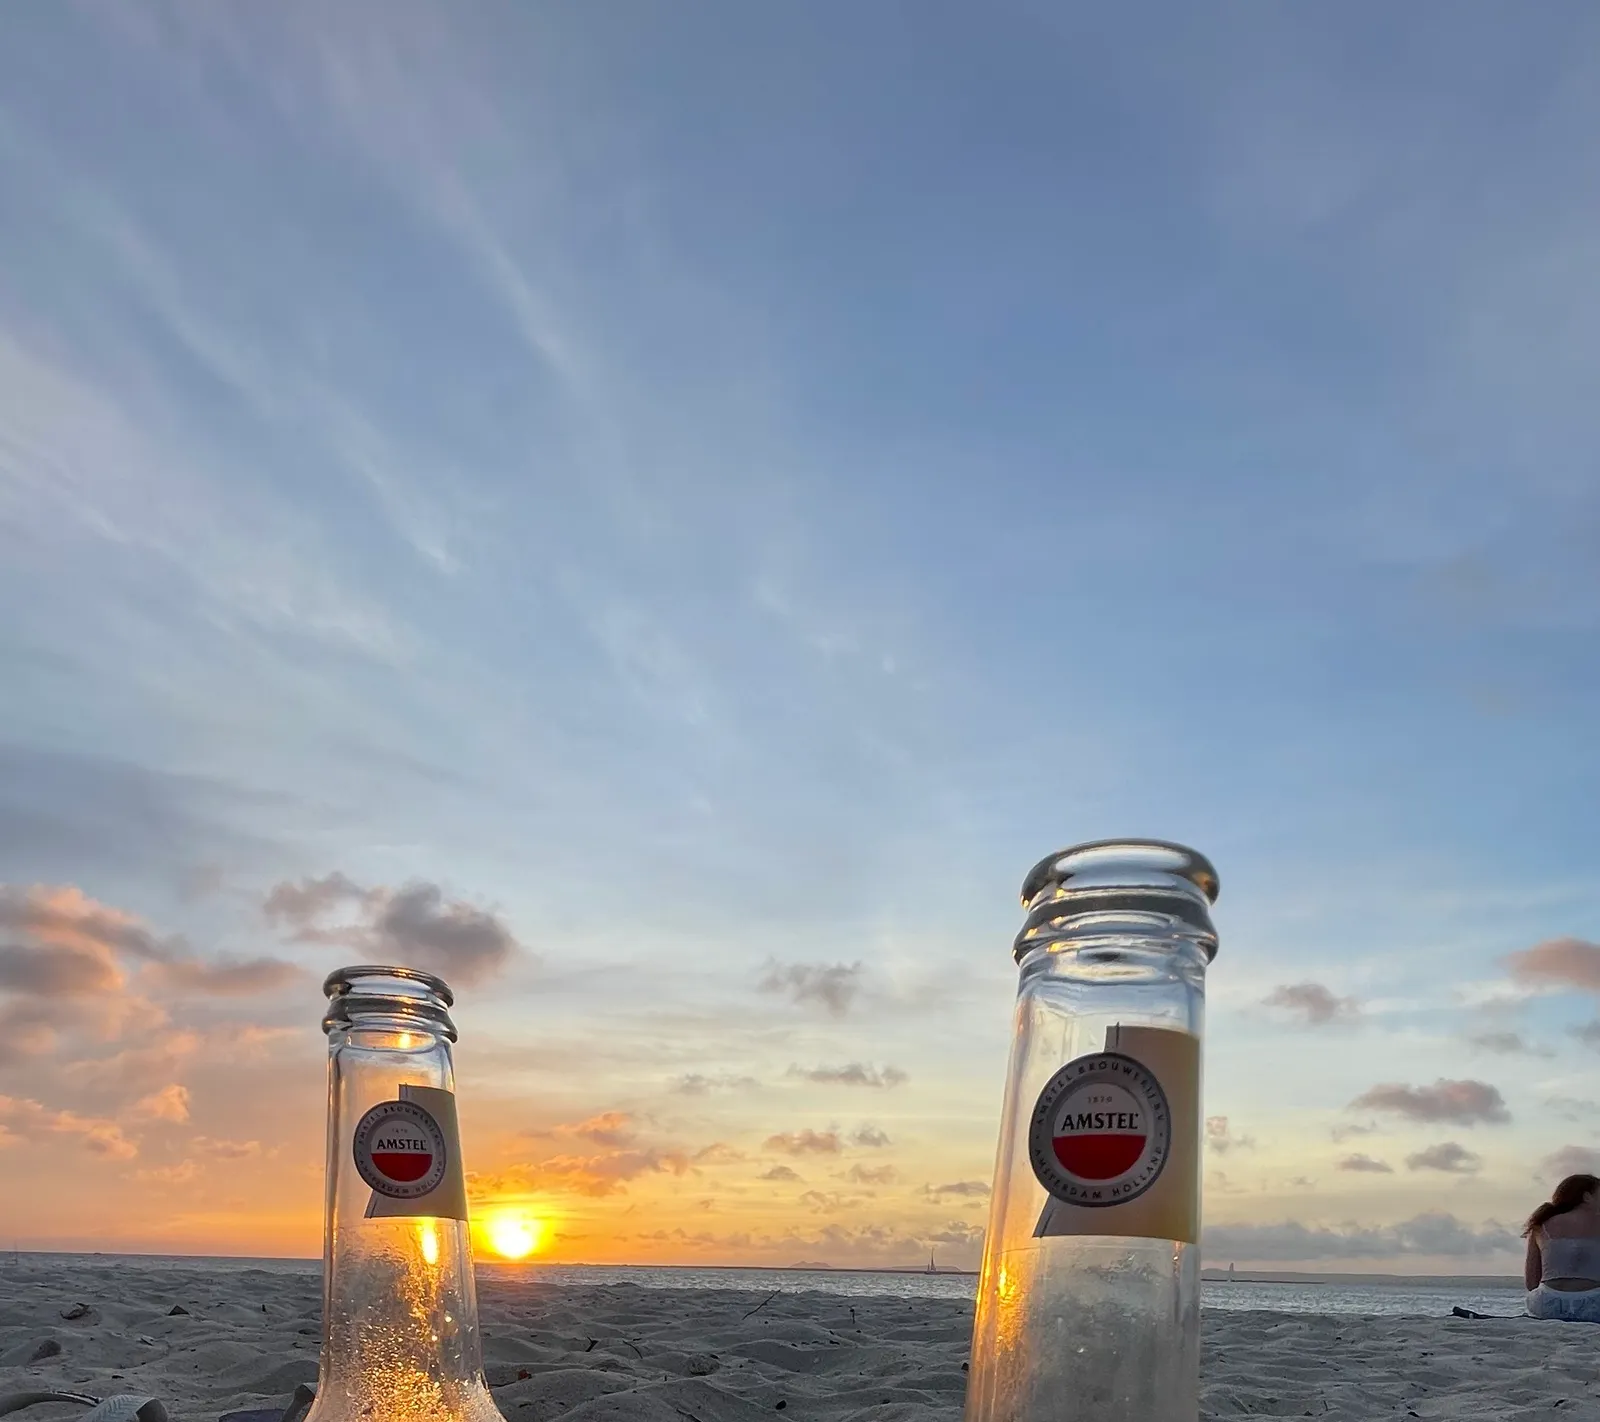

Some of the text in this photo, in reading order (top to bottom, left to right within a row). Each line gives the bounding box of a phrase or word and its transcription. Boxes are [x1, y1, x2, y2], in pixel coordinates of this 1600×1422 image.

[1060, 1112, 1139, 1131] AMSTEL
[376, 1138, 427, 1151] AMSTEL
[1034, 1146, 1163, 1200] AMSTERDAM HOLLAND
